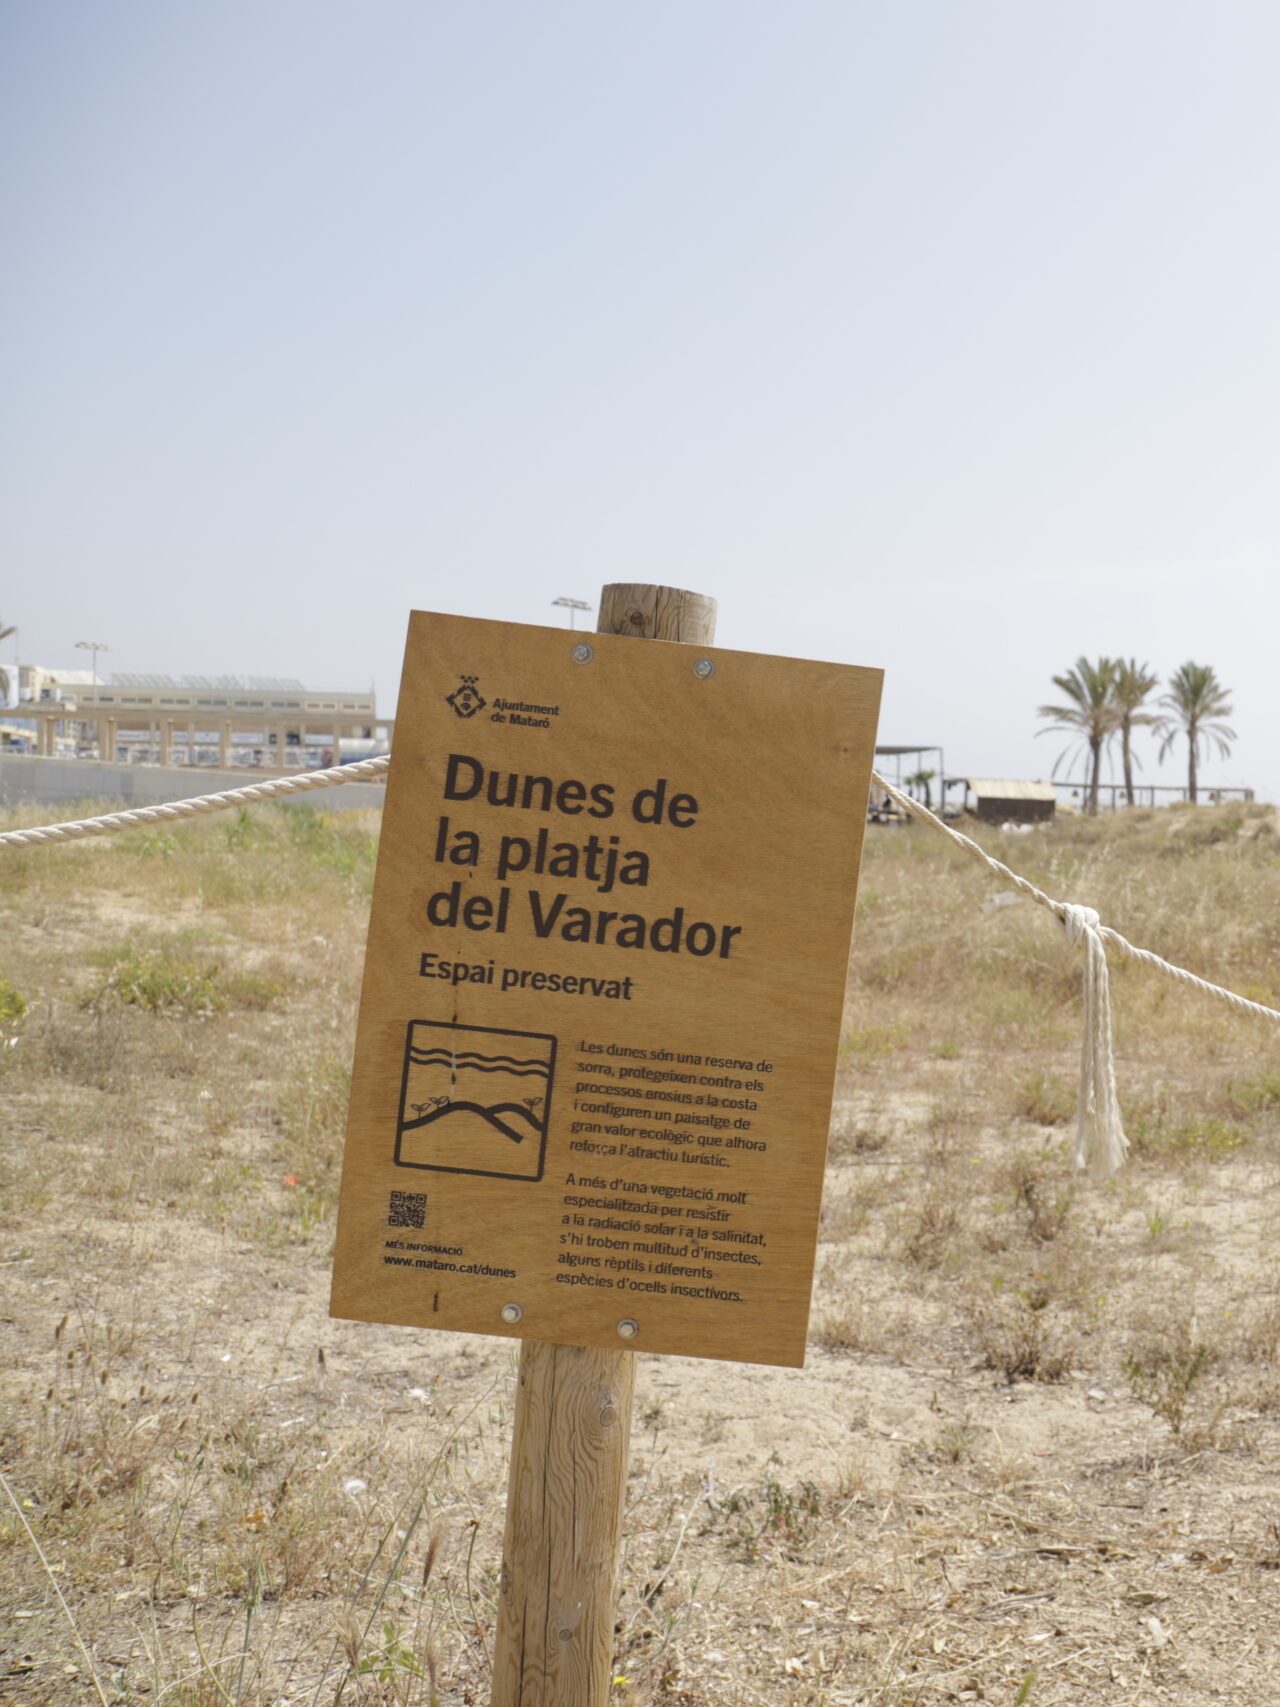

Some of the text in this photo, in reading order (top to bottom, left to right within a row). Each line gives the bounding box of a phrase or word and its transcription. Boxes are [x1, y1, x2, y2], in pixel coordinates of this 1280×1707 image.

[490, 711, 550, 729] de Mataró
[492, 697, 560, 716] Ajuntament
[443, 753, 699, 829] Dunes de
[434, 815, 650, 894] la platja
[426, 880, 742, 960] del Varador
[419, 952, 634, 1001] Espai preservat
[580, 1040, 773, 1073] Les dunes són una reserva de
[577, 1062, 764, 1092] sorra, protegeixen contra els
[575, 1082, 758, 1111] processos erosius a la costa
[574, 1098, 751, 1130] i configuren un paisatge de
[570, 1121, 767, 1152] gran valor ecològic que alhora
[569, 1139, 617, 1156] reforça
[681, 1151, 730, 1168] turístic.
[565, 1173, 576, 1186] A
[578, 1176, 607, 1189] més
[650, 1185, 714, 1201] vegetació
[716, 1191, 748, 1205] molt
[563, 1195, 731, 1222] especialitzada per resistir
[561, 1213, 767, 1248] a la radiació solar i a la salinitat,
[385, 1240, 463, 1256] MÉS INFORMACIÓ
[586, 1234, 630, 1251] troben
[632, 1241, 689, 1257] multitud
[690, 1246, 762, 1267] d'insectes,
[383, 1255, 517, 1278] www.mataro.cat/dunes
[557, 1252, 713, 1279] alguns rèptils i diferents
[555, 1272, 614, 1288] espècies
[670, 1282, 744, 1302] insectívors.
